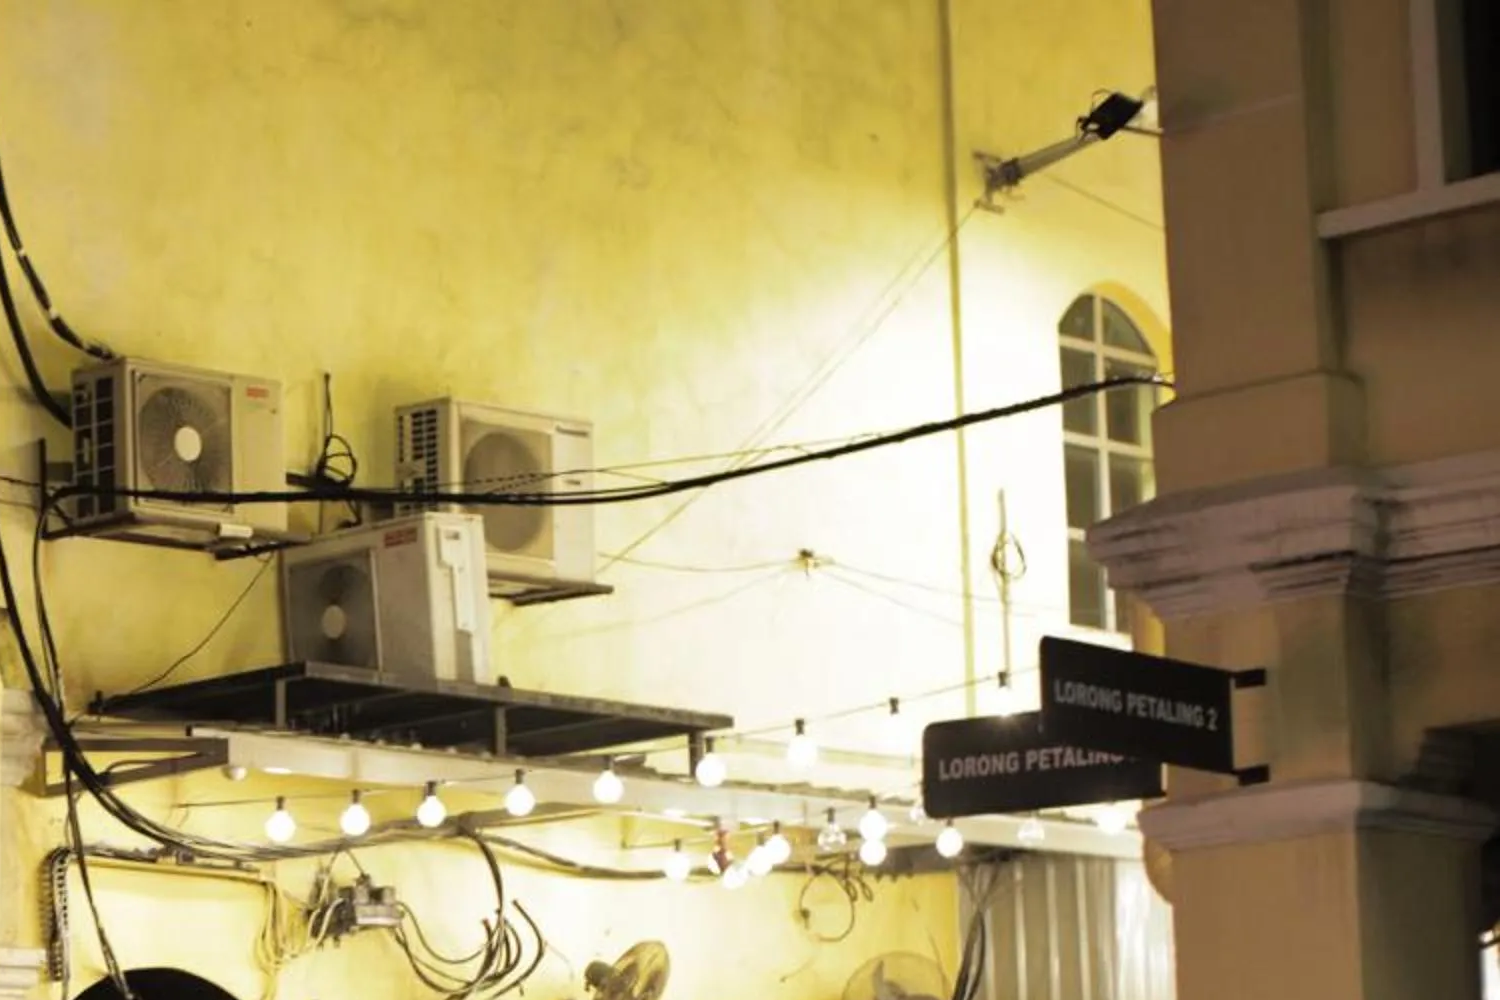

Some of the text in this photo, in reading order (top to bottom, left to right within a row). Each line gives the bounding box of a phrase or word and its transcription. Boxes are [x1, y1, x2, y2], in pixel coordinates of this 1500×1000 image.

[1054, 679, 1219, 732] LORONG PETALING 2
[939, 751, 1020, 781] LORONG
